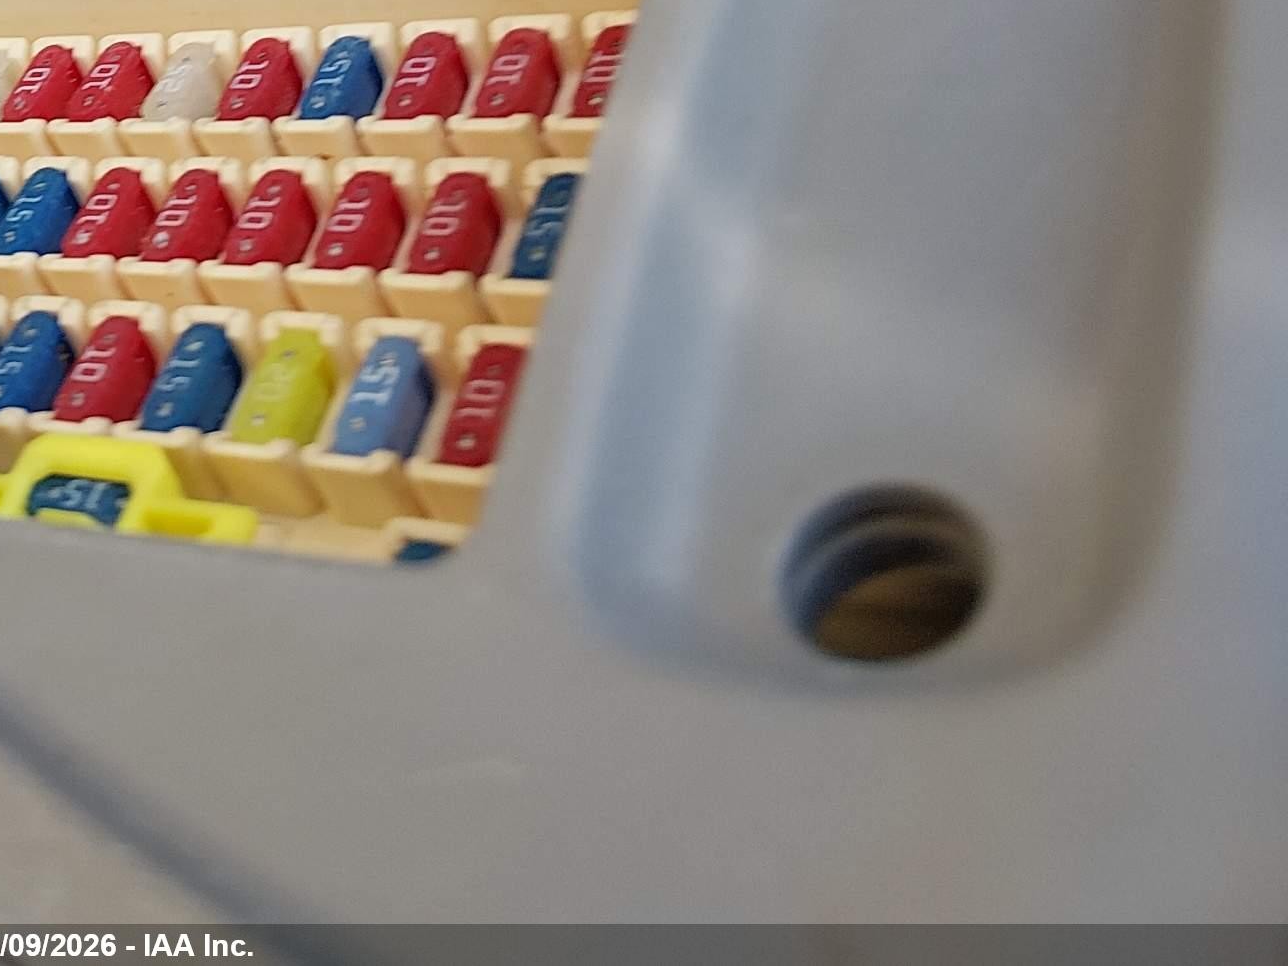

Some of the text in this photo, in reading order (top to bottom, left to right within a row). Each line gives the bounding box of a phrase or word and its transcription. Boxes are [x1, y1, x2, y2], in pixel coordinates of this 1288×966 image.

[14, 67, 51, 95] 10
[81, 63, 120, 91] 10
[229, 60, 270, 89] 10
[313, 58, 352, 86] 15
[394, 56, 437, 87] 10
[486, 53, 530, 85] 10
[5, 194, 44, 222] 15
[76, 194, 118, 225] 10
[155, 194, 197, 227] 10
[237, 195, 281, 229] 10
[326, 197, 371, 232] 10
[420, 199, 469, 236] 10
[70, 345, 117, 383] 10
